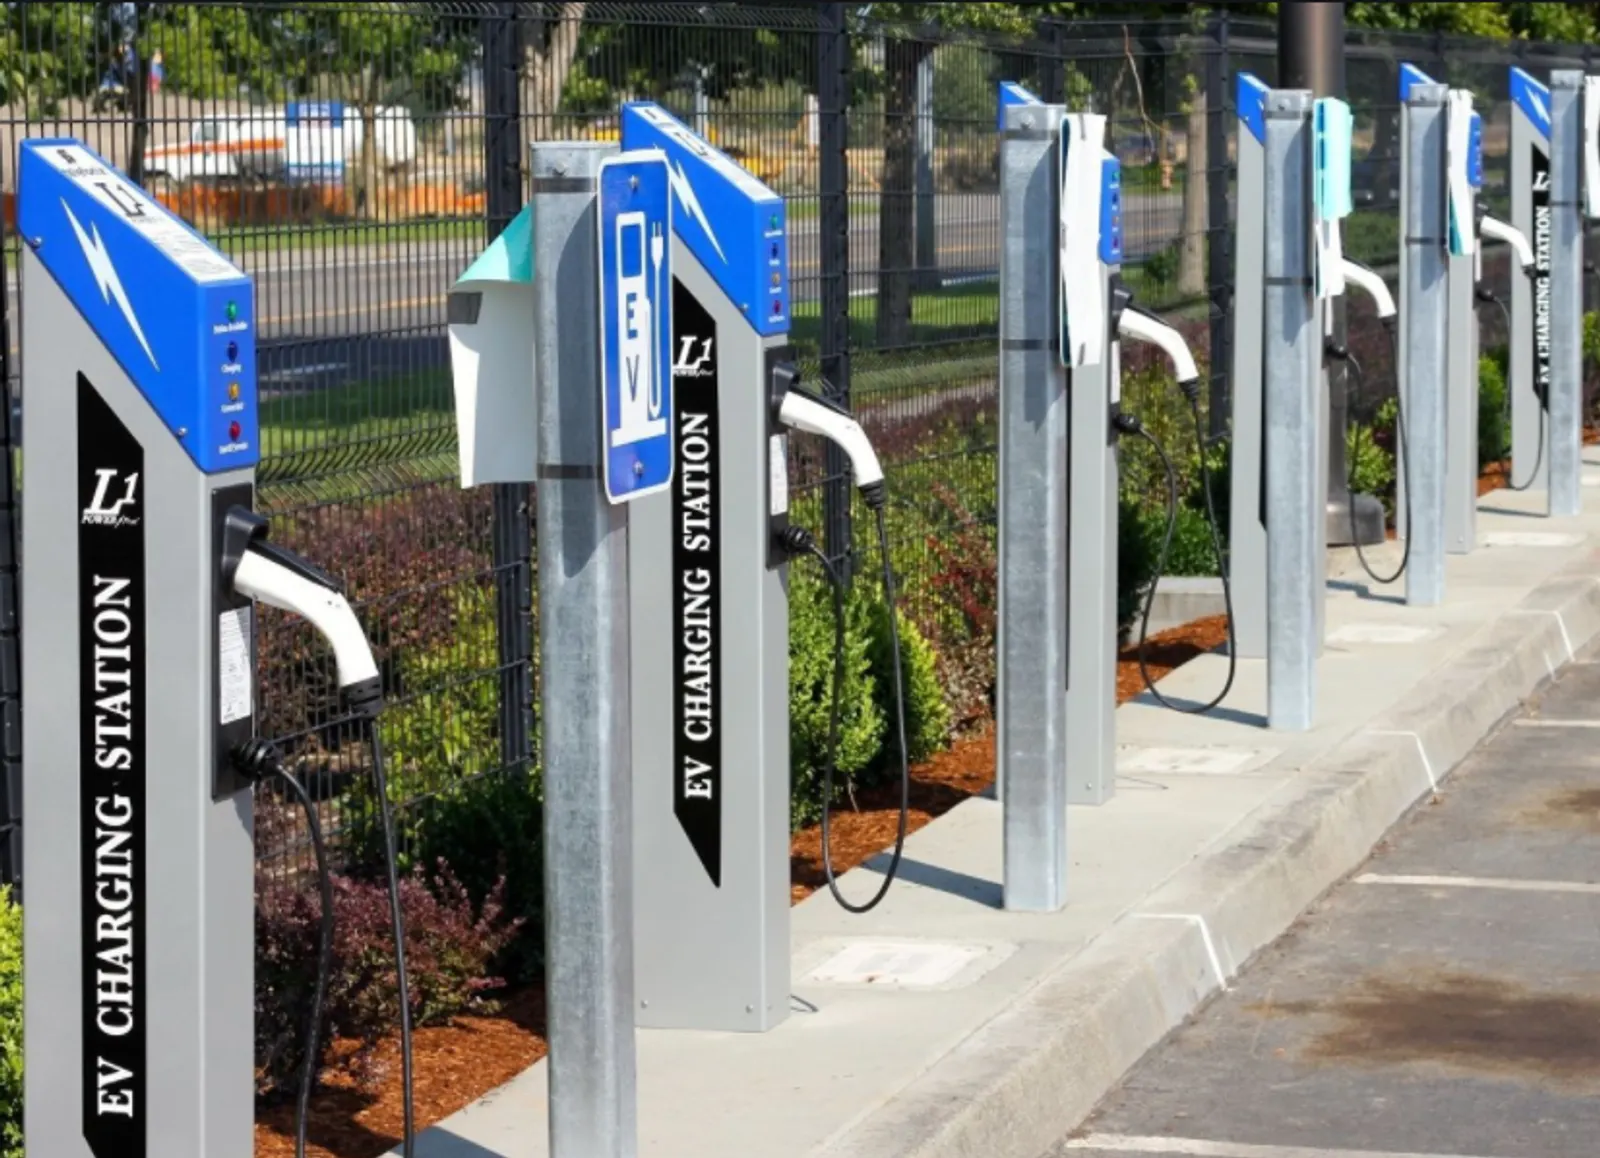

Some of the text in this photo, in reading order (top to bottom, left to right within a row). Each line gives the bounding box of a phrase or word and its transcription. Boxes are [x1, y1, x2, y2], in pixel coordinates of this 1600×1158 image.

[1532, 171, 1550, 191] L
[1535, 205, 1550, 270] STATION
[1536, 277, 1550, 358] CHARGING
[83, 468, 139, 515] L1
[681, 411, 713, 800] EV CHARGING STATION
[93, 574, 134, 1118] EV CHARGING STATION
